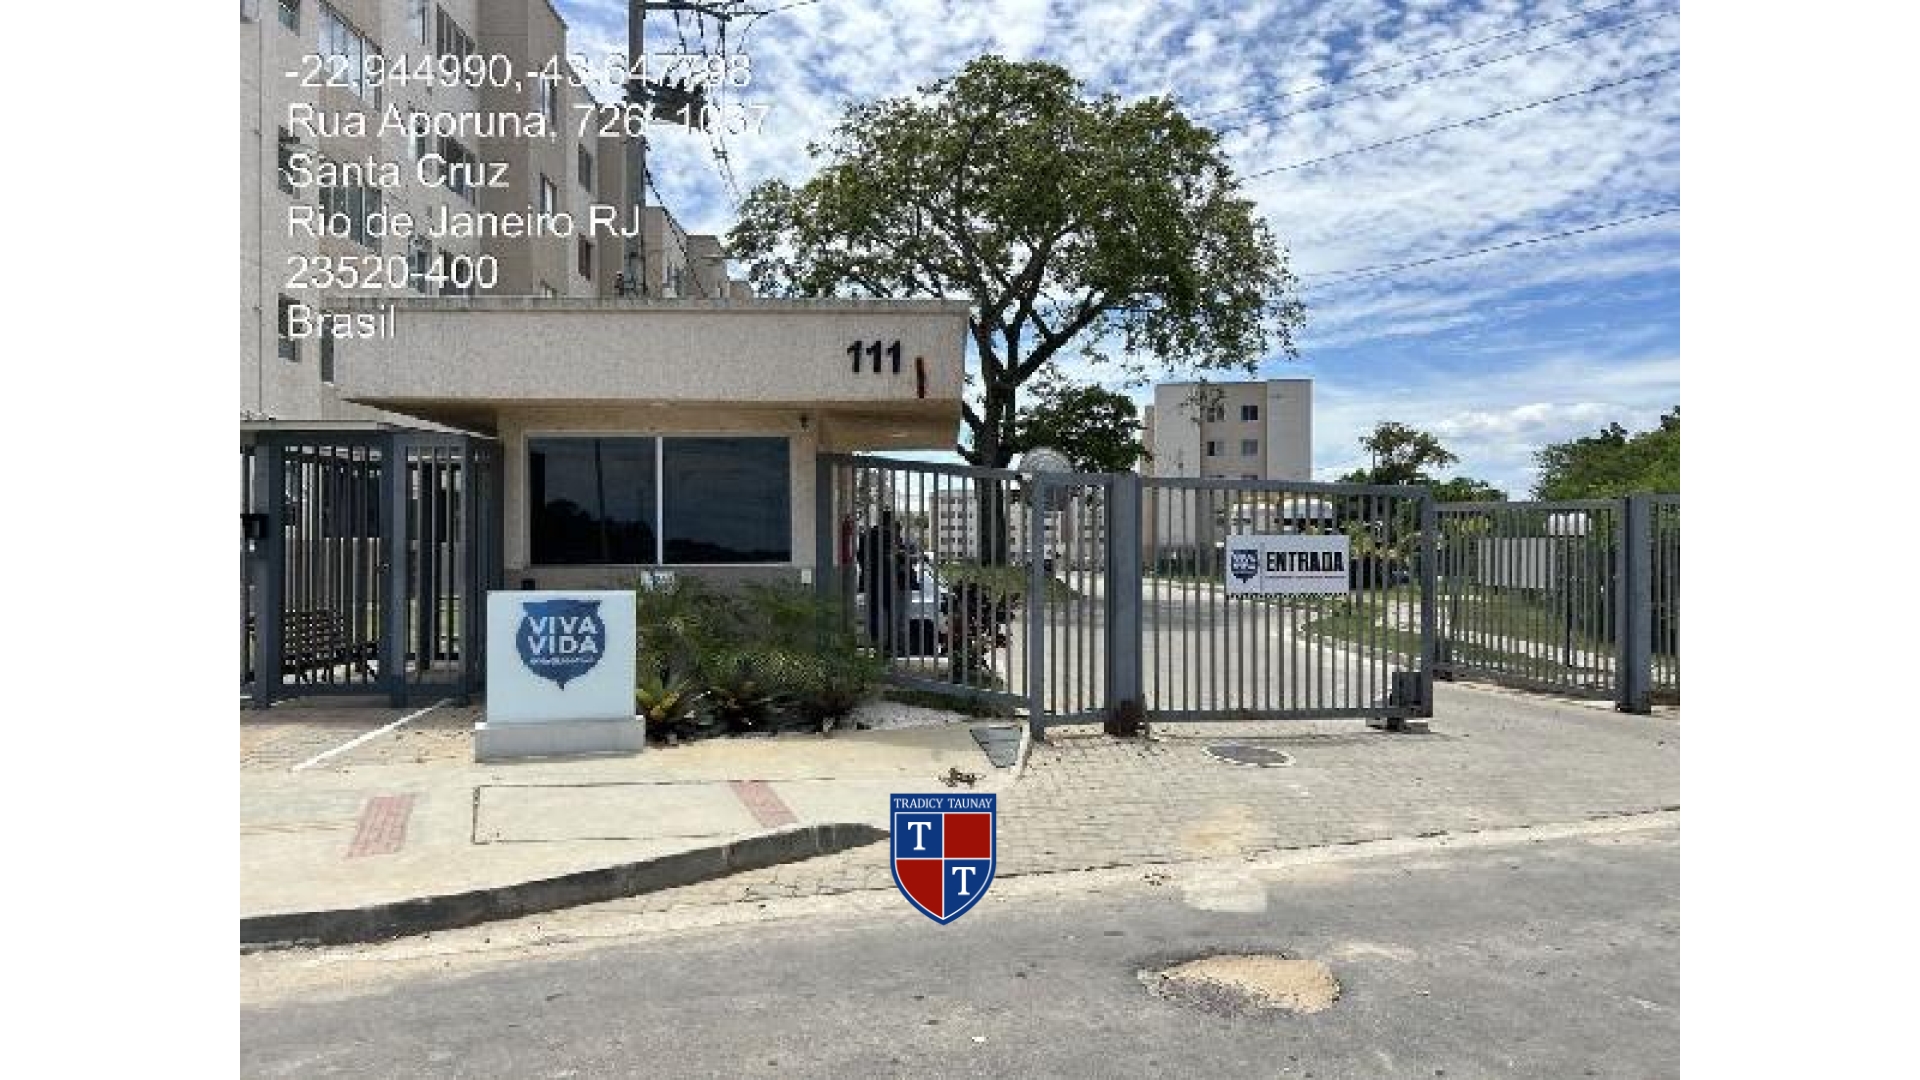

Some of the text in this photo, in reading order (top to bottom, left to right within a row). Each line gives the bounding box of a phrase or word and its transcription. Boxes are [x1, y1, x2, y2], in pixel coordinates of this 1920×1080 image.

[846, 340, 901, 374] 111
[1266, 551, 1345, 572] ENTRADA
[527, 616, 599, 635] VIVA
[527, 635, 599, 654] VIDA
